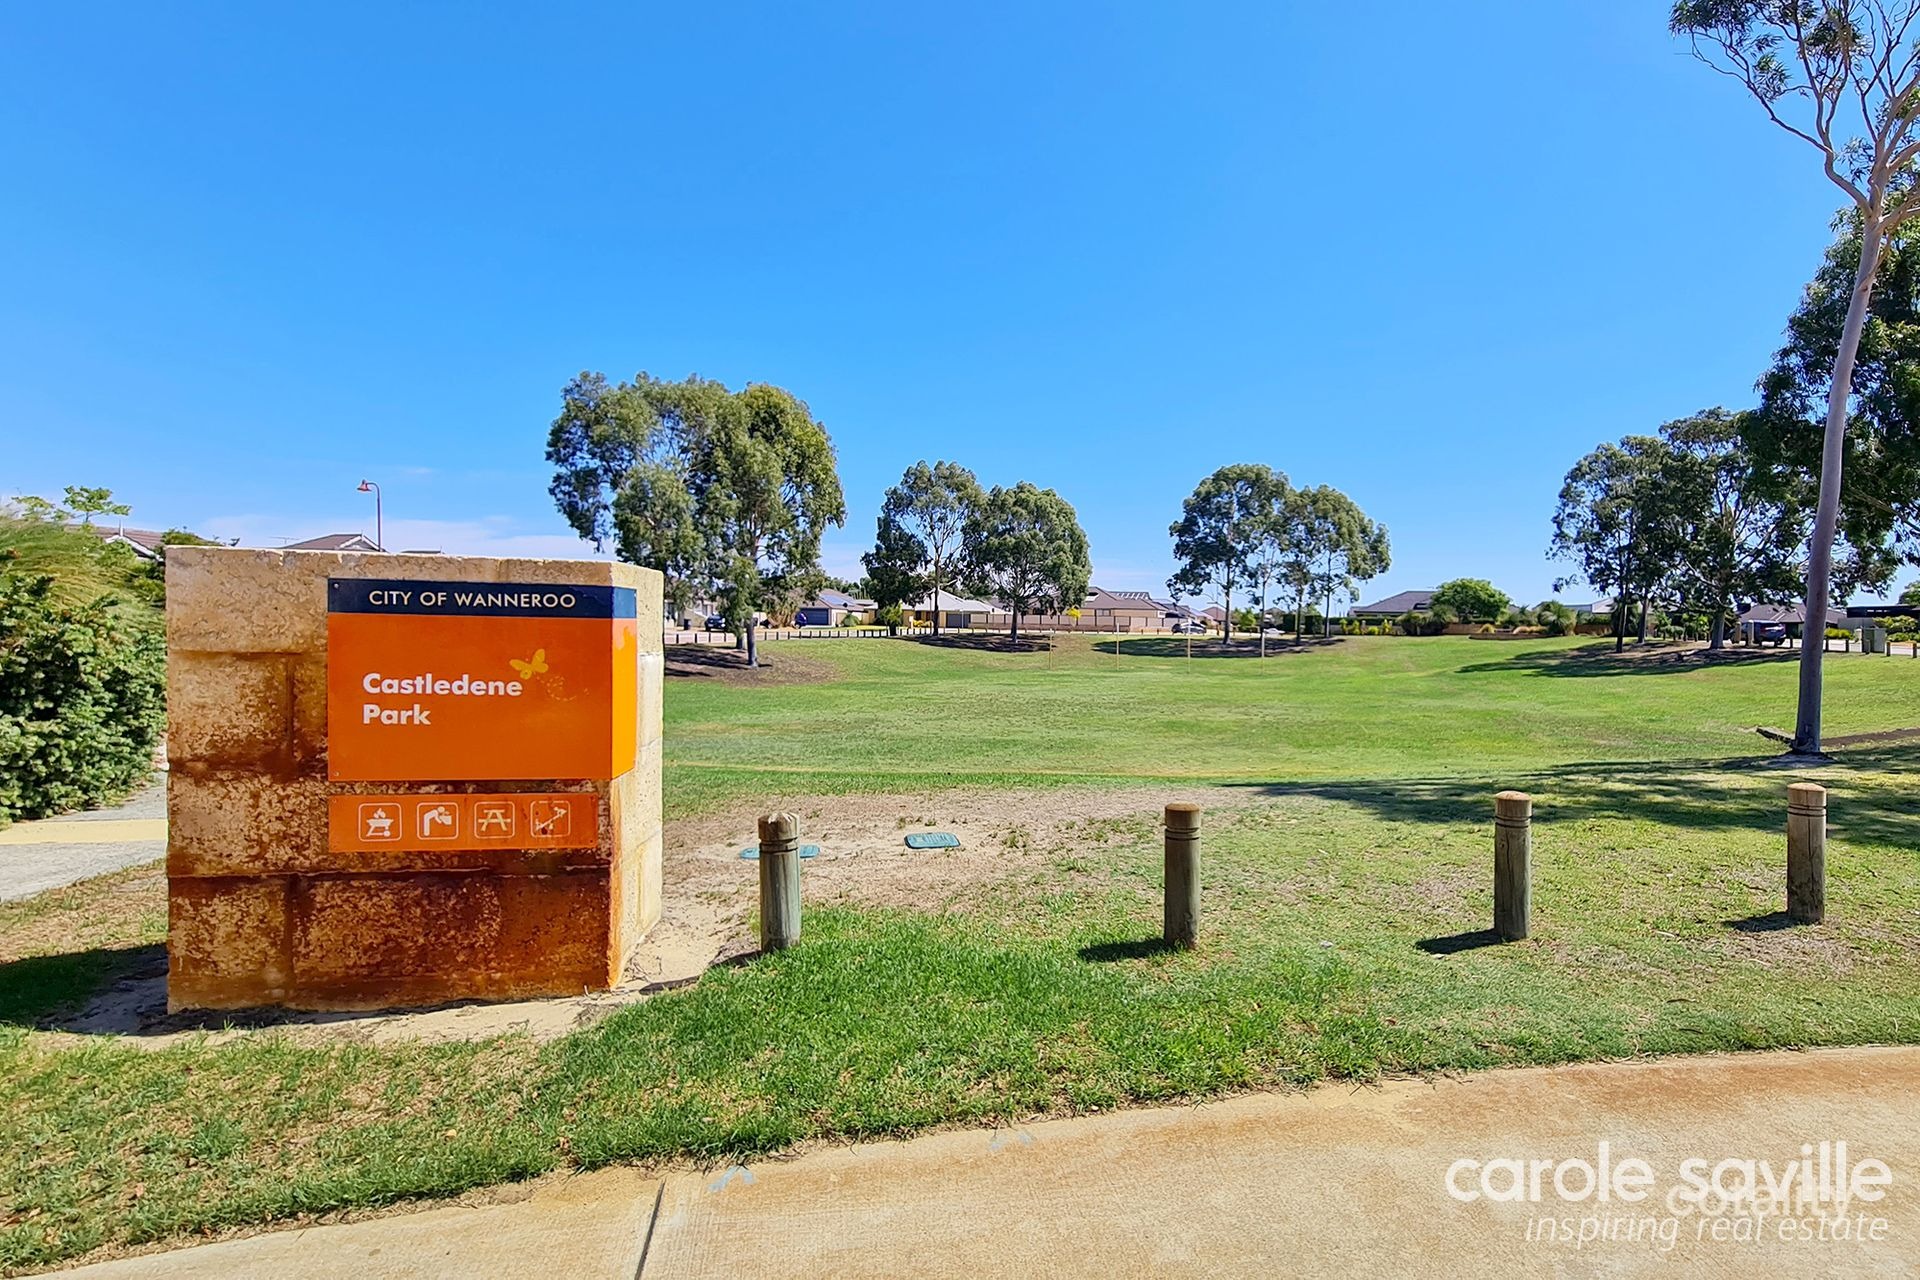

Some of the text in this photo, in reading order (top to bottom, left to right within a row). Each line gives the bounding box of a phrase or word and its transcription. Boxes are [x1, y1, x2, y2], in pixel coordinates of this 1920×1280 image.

[368, 590, 576, 608] CITY OF WANNEROO
[362, 672, 523, 697] Castledene
[362, 703, 431, 725] Park
